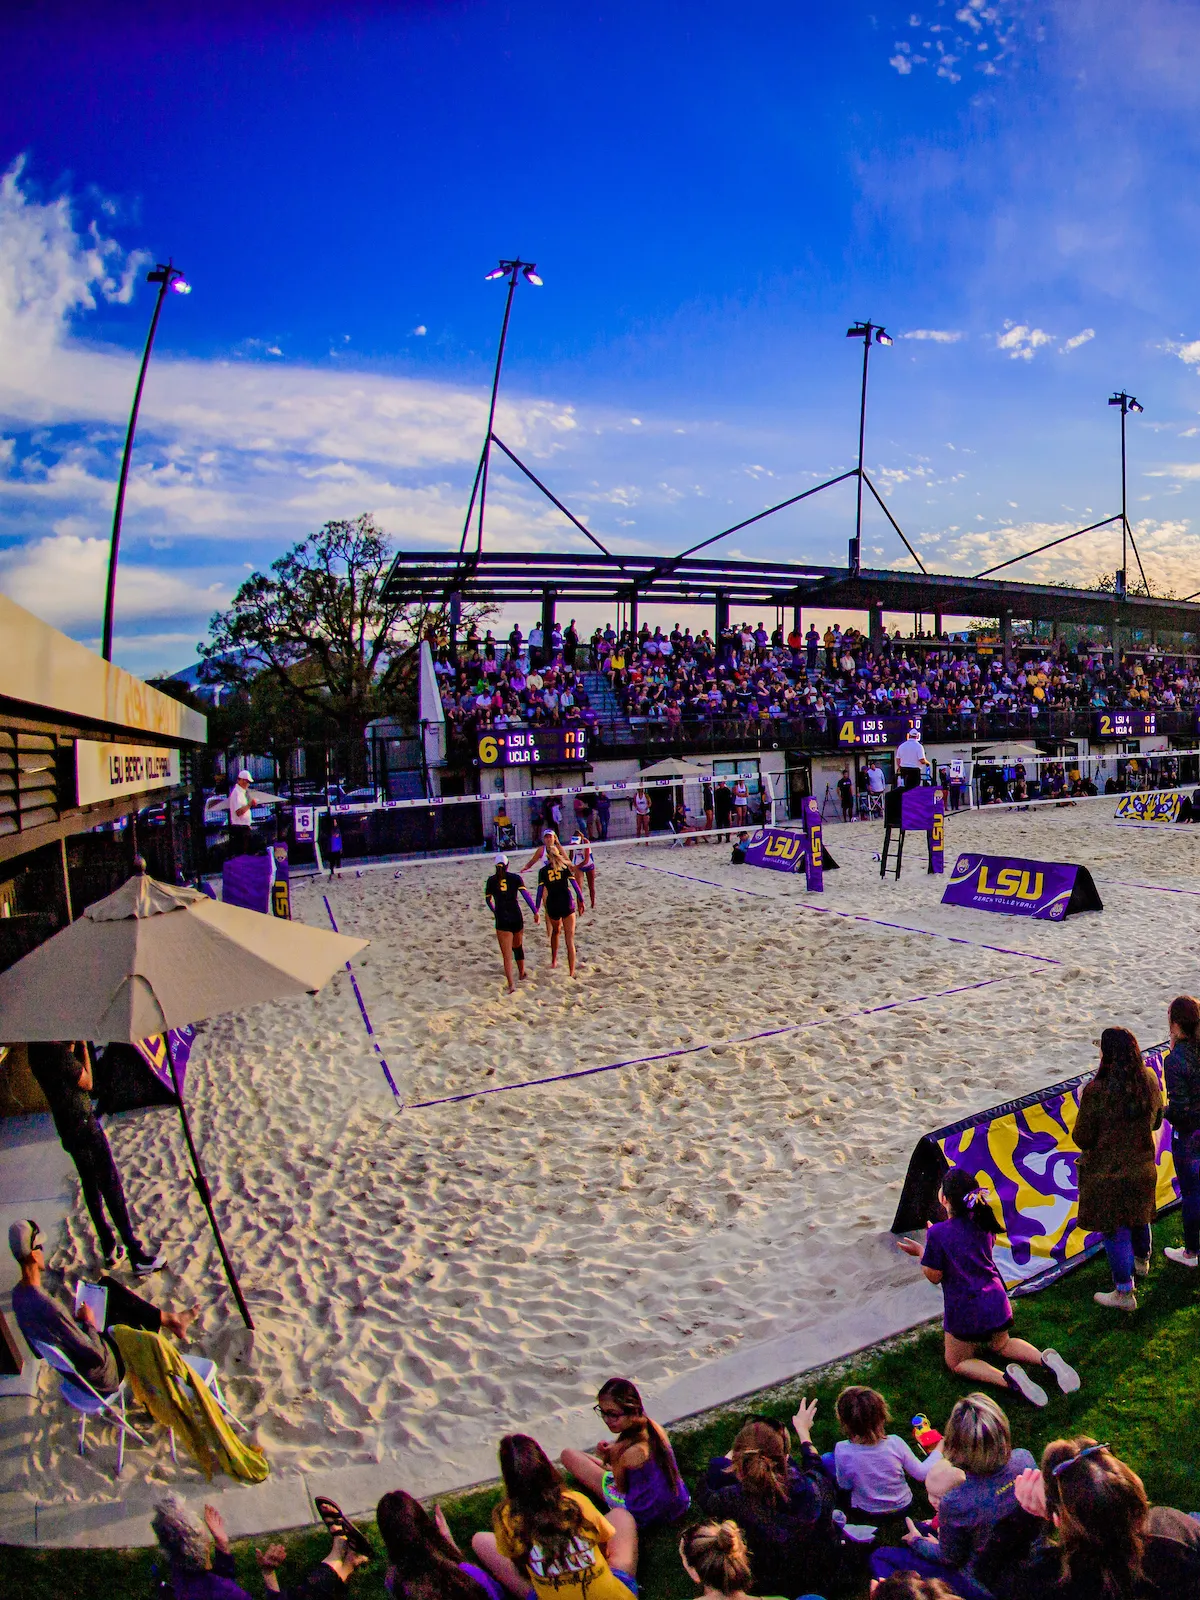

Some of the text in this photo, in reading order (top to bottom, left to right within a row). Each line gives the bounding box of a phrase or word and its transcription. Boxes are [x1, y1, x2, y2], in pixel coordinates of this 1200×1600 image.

[862, 720, 876, 730] LSU
[878, 720, 883, 730] 5
[915, 720, 921, 729] 0
[1100, 716, 1111, 734] 2
[1115, 716, 1124, 724] LSU
[508, 735, 525, 747] LSU
[528, 734, 535, 746] 6
[578, 732, 584, 743] 0
[839, 720, 856, 744] 4
[863, 734, 887, 743] UCLA 5
[478, 736, 498, 764] 6
[509, 747, 585, 763] UCLA 6 11 0
[110, 756, 123, 785] LSU
[933, 814, 944, 852] LSU
[765, 836, 800, 859] LSU
[811, 826, 822, 867] LSU
[548, 869, 561, 882] 25
[977, 866, 1044, 900] LSU
[500, 879, 508, 892] 5
[994, 898, 1036, 908] VOLLEYBALL
